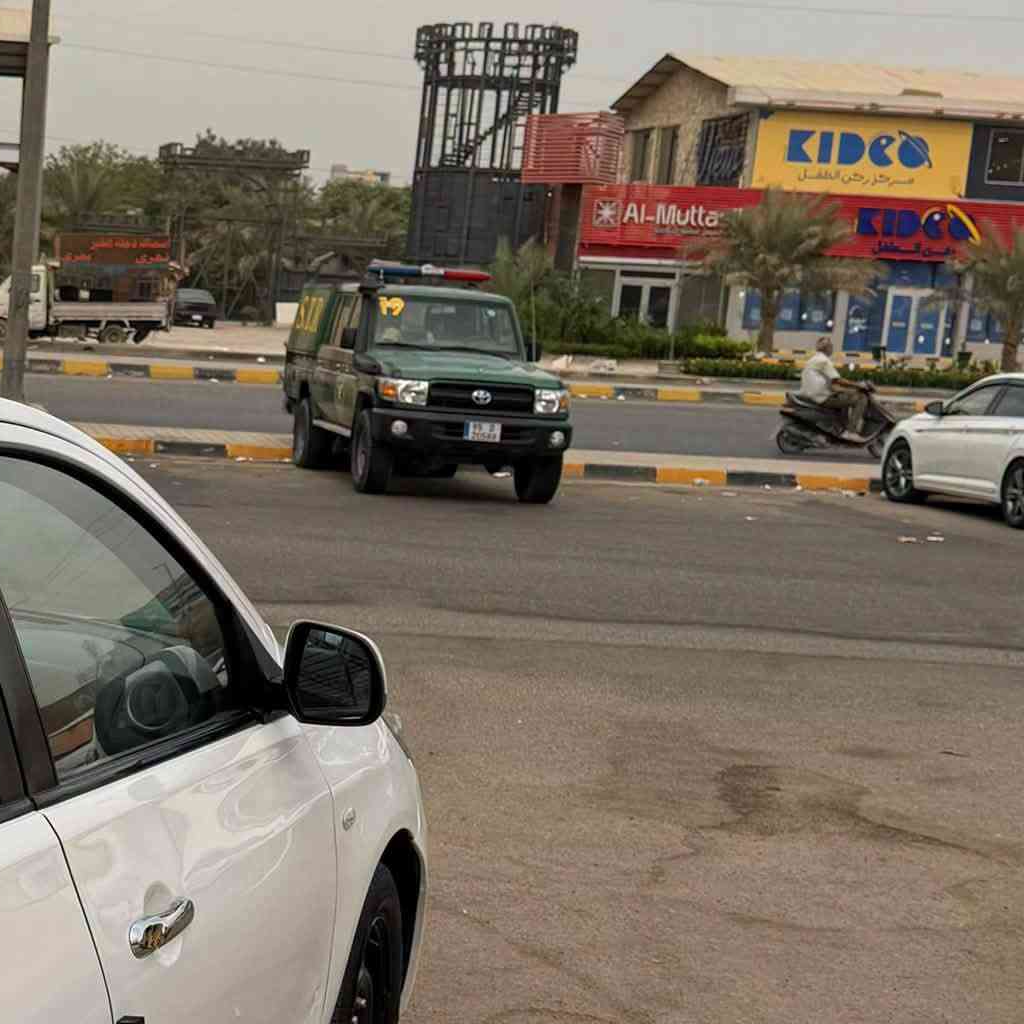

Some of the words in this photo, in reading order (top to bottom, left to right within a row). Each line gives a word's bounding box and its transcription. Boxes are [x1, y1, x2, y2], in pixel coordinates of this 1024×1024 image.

[787, 129, 933, 168] KIDCO
[872, 172, 915, 187] مركز
[622, 202, 725, 228] Al-Mutta
[857, 204, 982, 245] KIDCO
